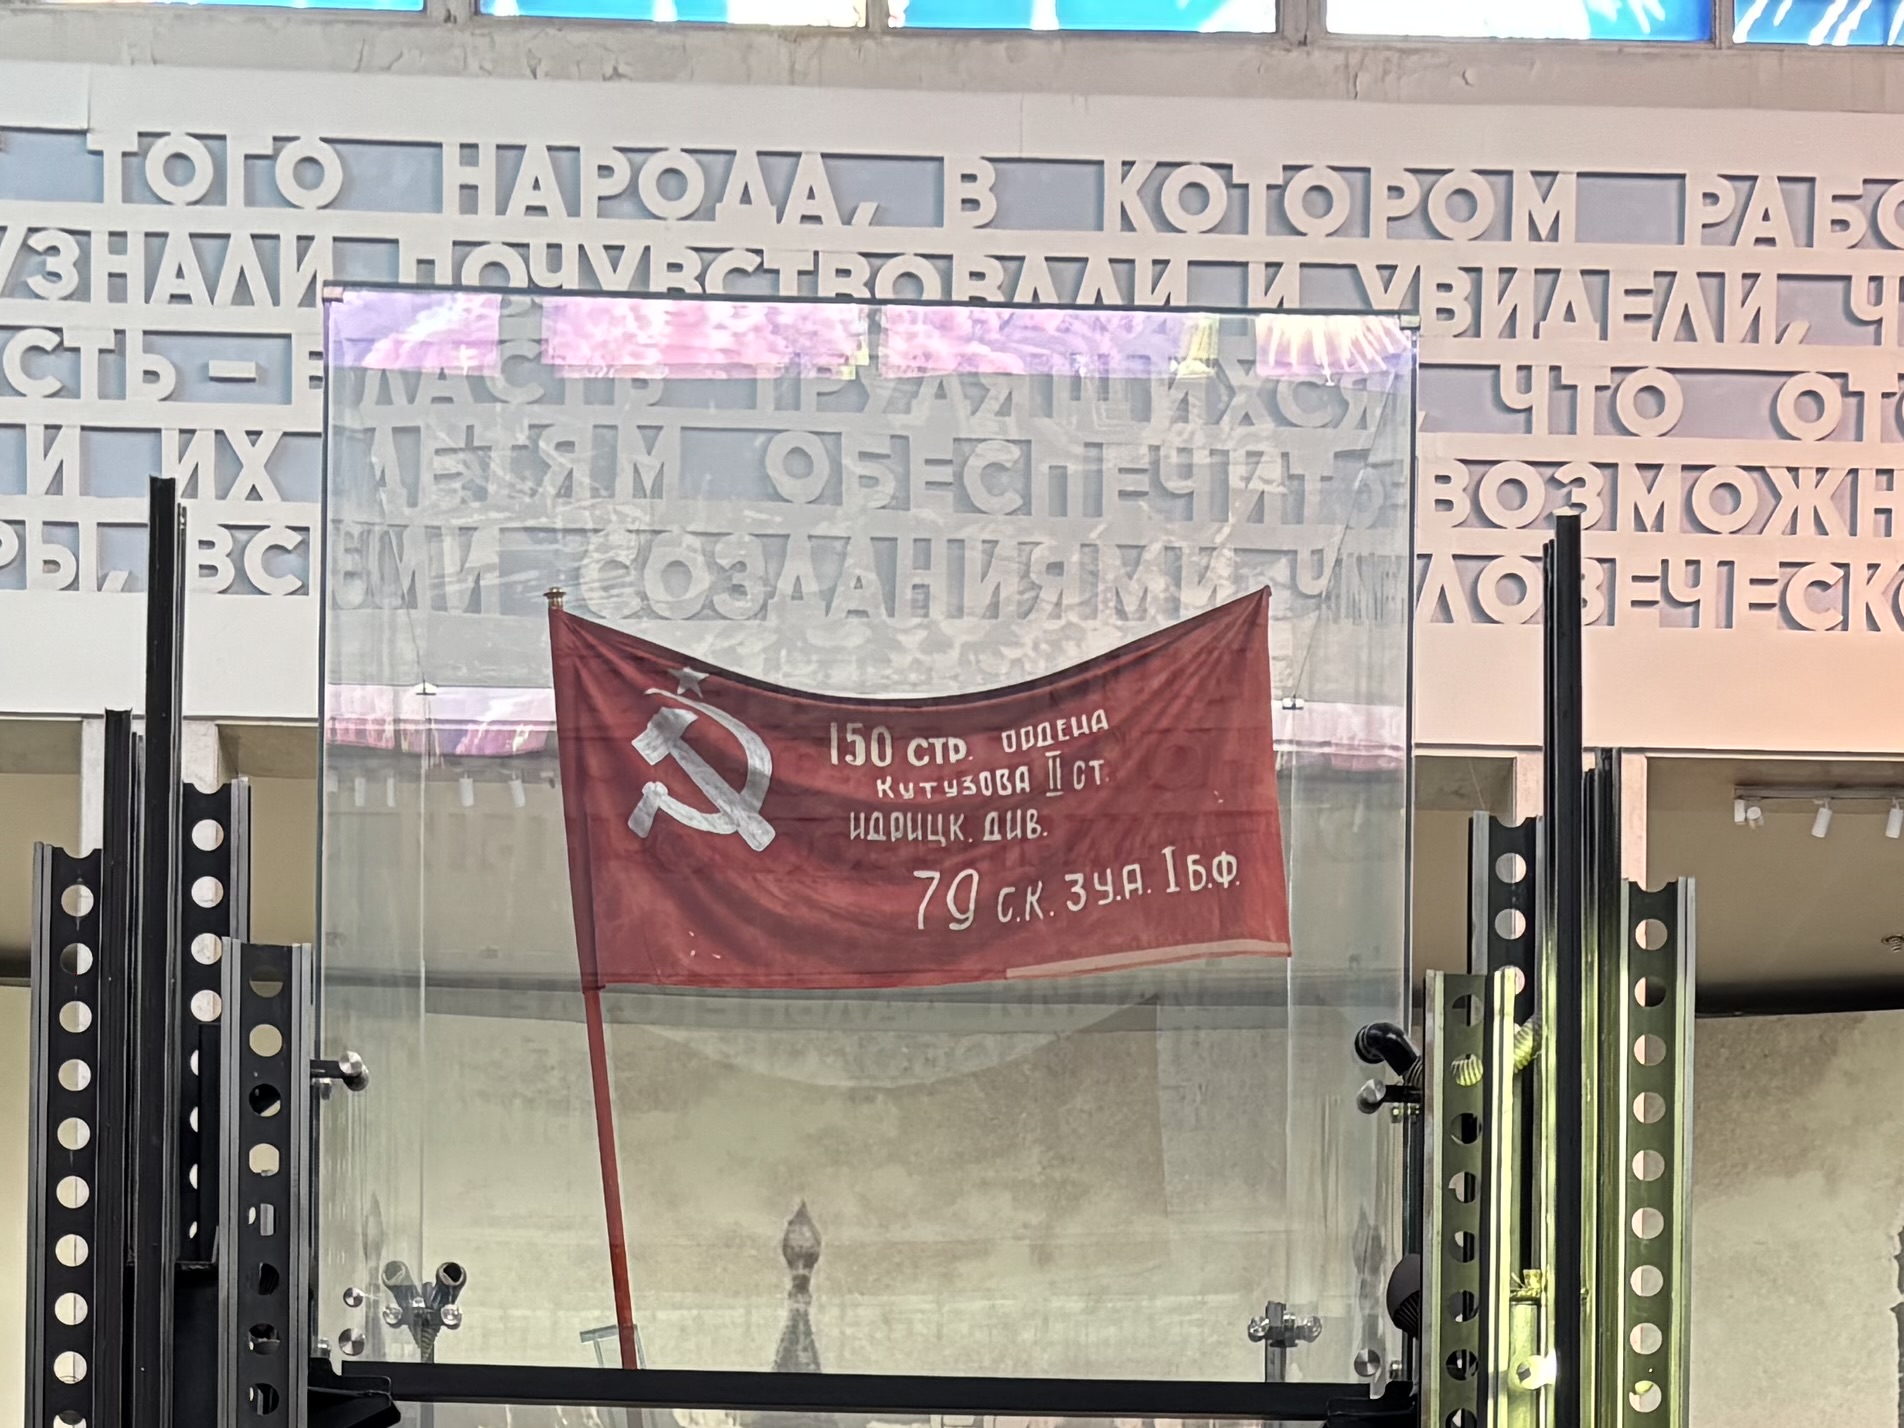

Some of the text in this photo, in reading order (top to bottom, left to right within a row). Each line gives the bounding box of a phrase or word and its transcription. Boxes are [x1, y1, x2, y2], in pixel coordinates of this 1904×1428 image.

[88, 132, 343, 208] ТОГО
[457, 143, 879, 227] НАРОДА,
[957, 157, 998, 229] В
[1116, 162, 1577, 245] КОТОРОМ
[1497, 367, 1683, 438] ЧТО
[28, 426, 80, 498] И
[162, 429, 283, 501] ИХ
[829, 721, 893, 767] 150
[1000, 707, 1110, 754] ОРДЕНА
[982, 808, 1049, 842] ДИВ.
[912, 867, 980, 932] 79
